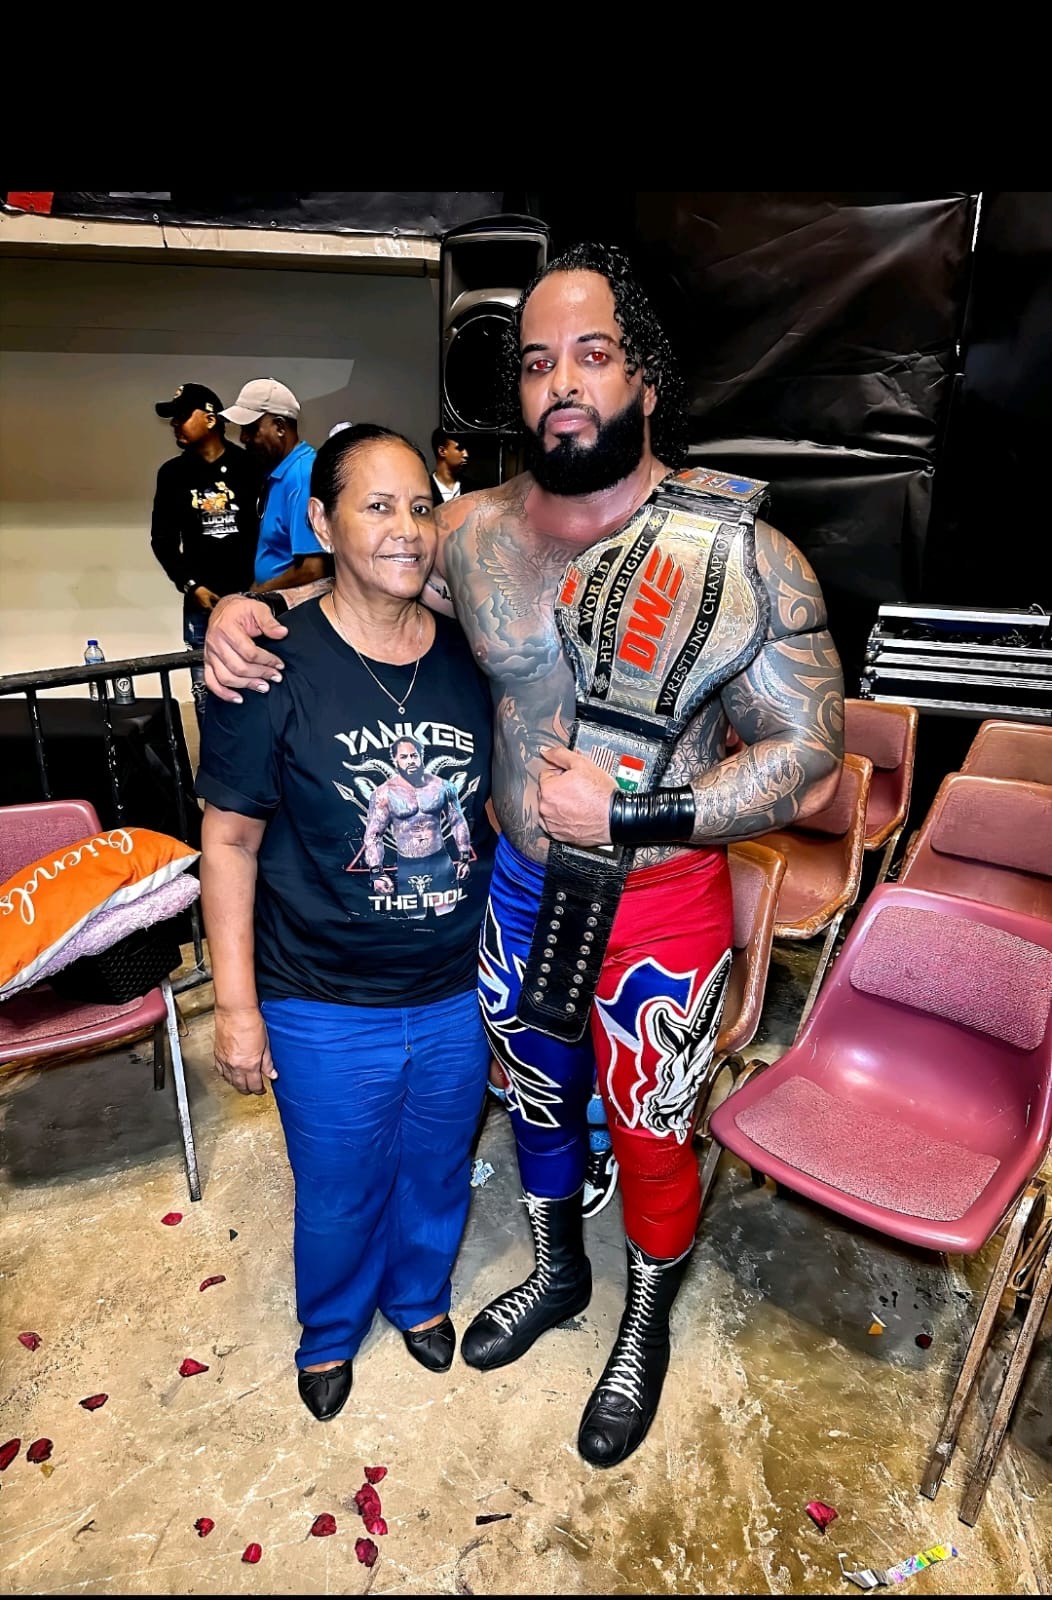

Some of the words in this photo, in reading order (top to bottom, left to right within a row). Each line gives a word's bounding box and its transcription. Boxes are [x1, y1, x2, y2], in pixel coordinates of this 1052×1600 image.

[579, 560, 611, 627] WORLD
[600, 535, 651, 664] HEAVYWEIGHT
[616, 545, 686, 674] DWE
[660, 619, 710, 708] WRESTLING
[334, 719, 475, 756] YANKEE
[368, 893, 418, 912] THE
[422, 887, 468, 908] IDOL
